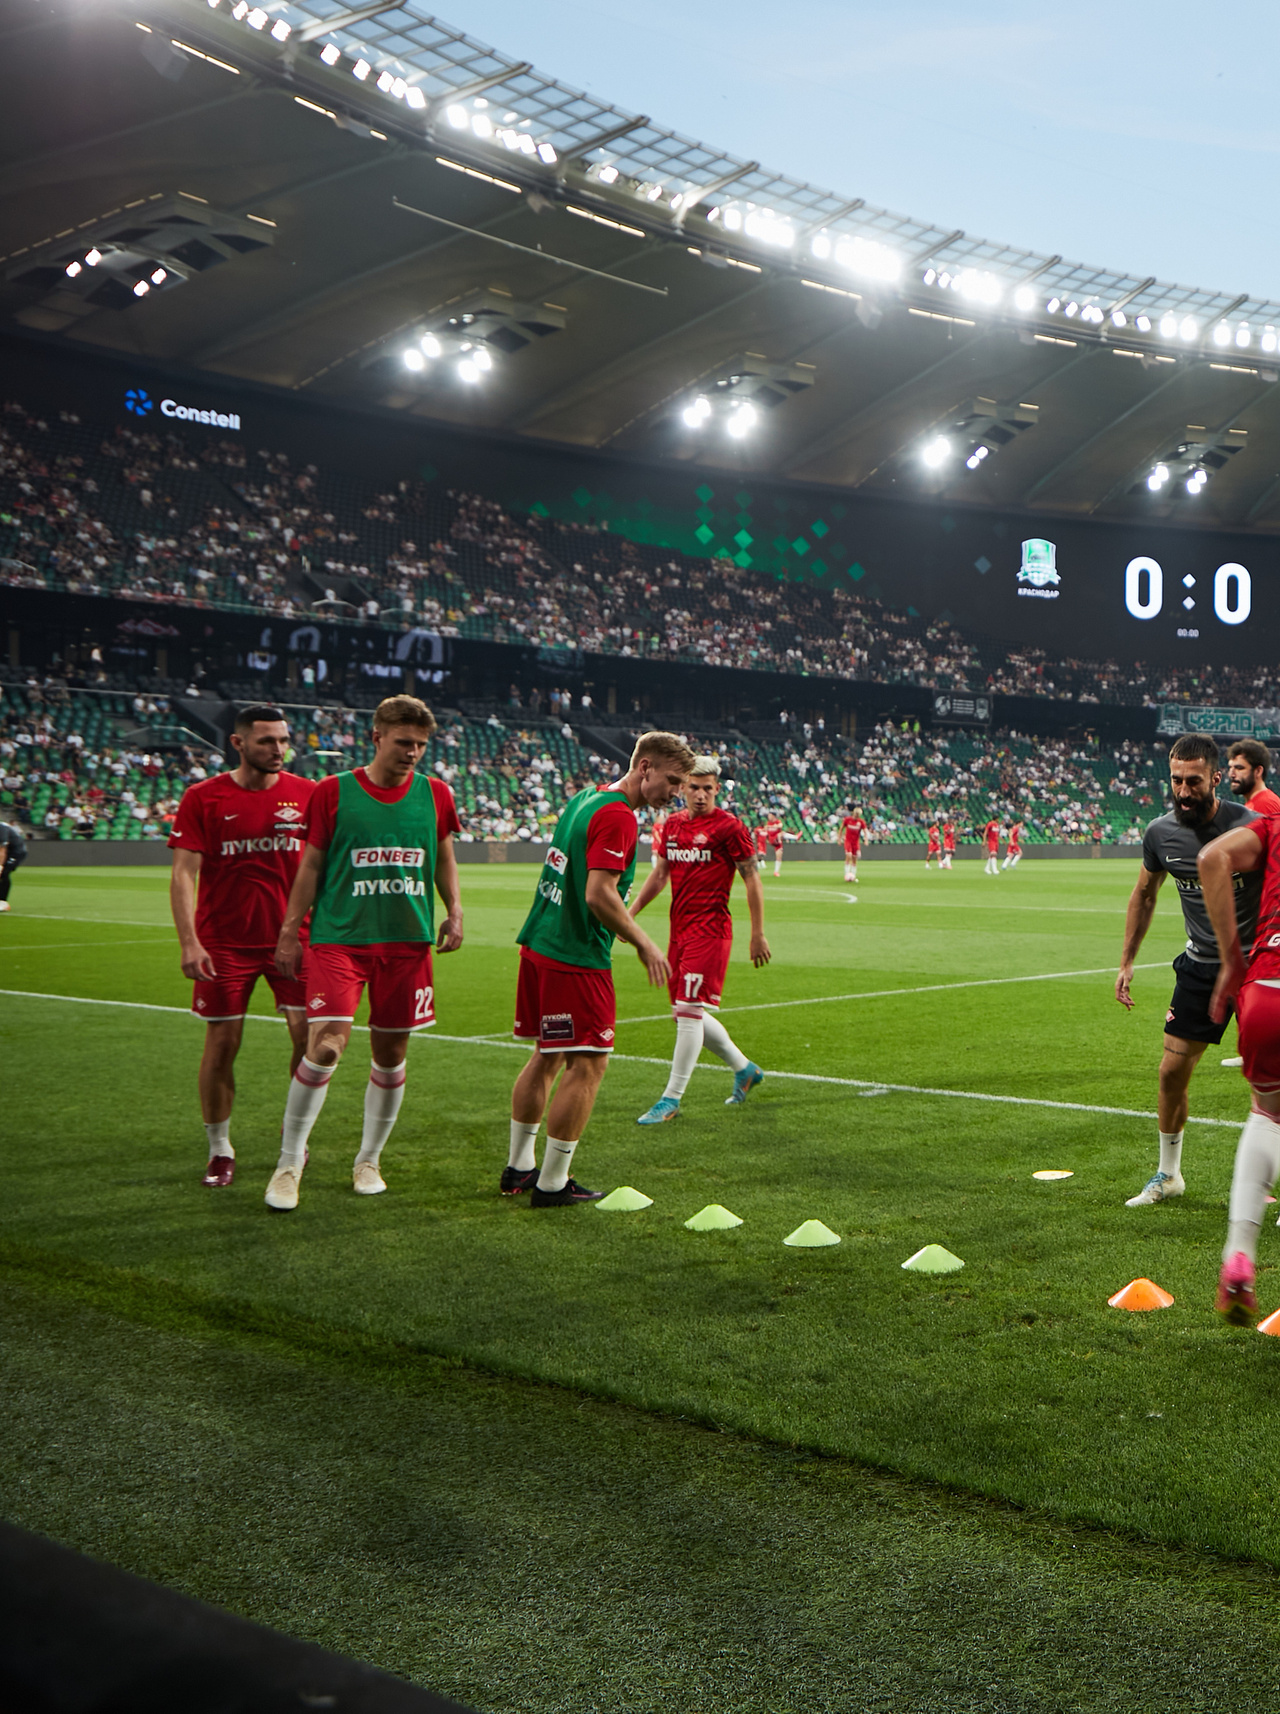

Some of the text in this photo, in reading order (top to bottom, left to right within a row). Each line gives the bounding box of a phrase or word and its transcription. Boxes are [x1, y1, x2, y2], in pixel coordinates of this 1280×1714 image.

[160, 399, 240, 430] Constell
[1017, 587, 1060, 598] КРАСНОДАР
[1125, 556, 1163, 620] 0
[1214, 562, 1252, 625] 0
[221, 834, 300, 856] ЛУКОЙЛ
[356, 850, 421, 864] FONBET
[352, 876, 425, 897] ЛУКОЙЛ
[684, 973, 703, 998] 17
[415, 986, 434, 1020] 22
